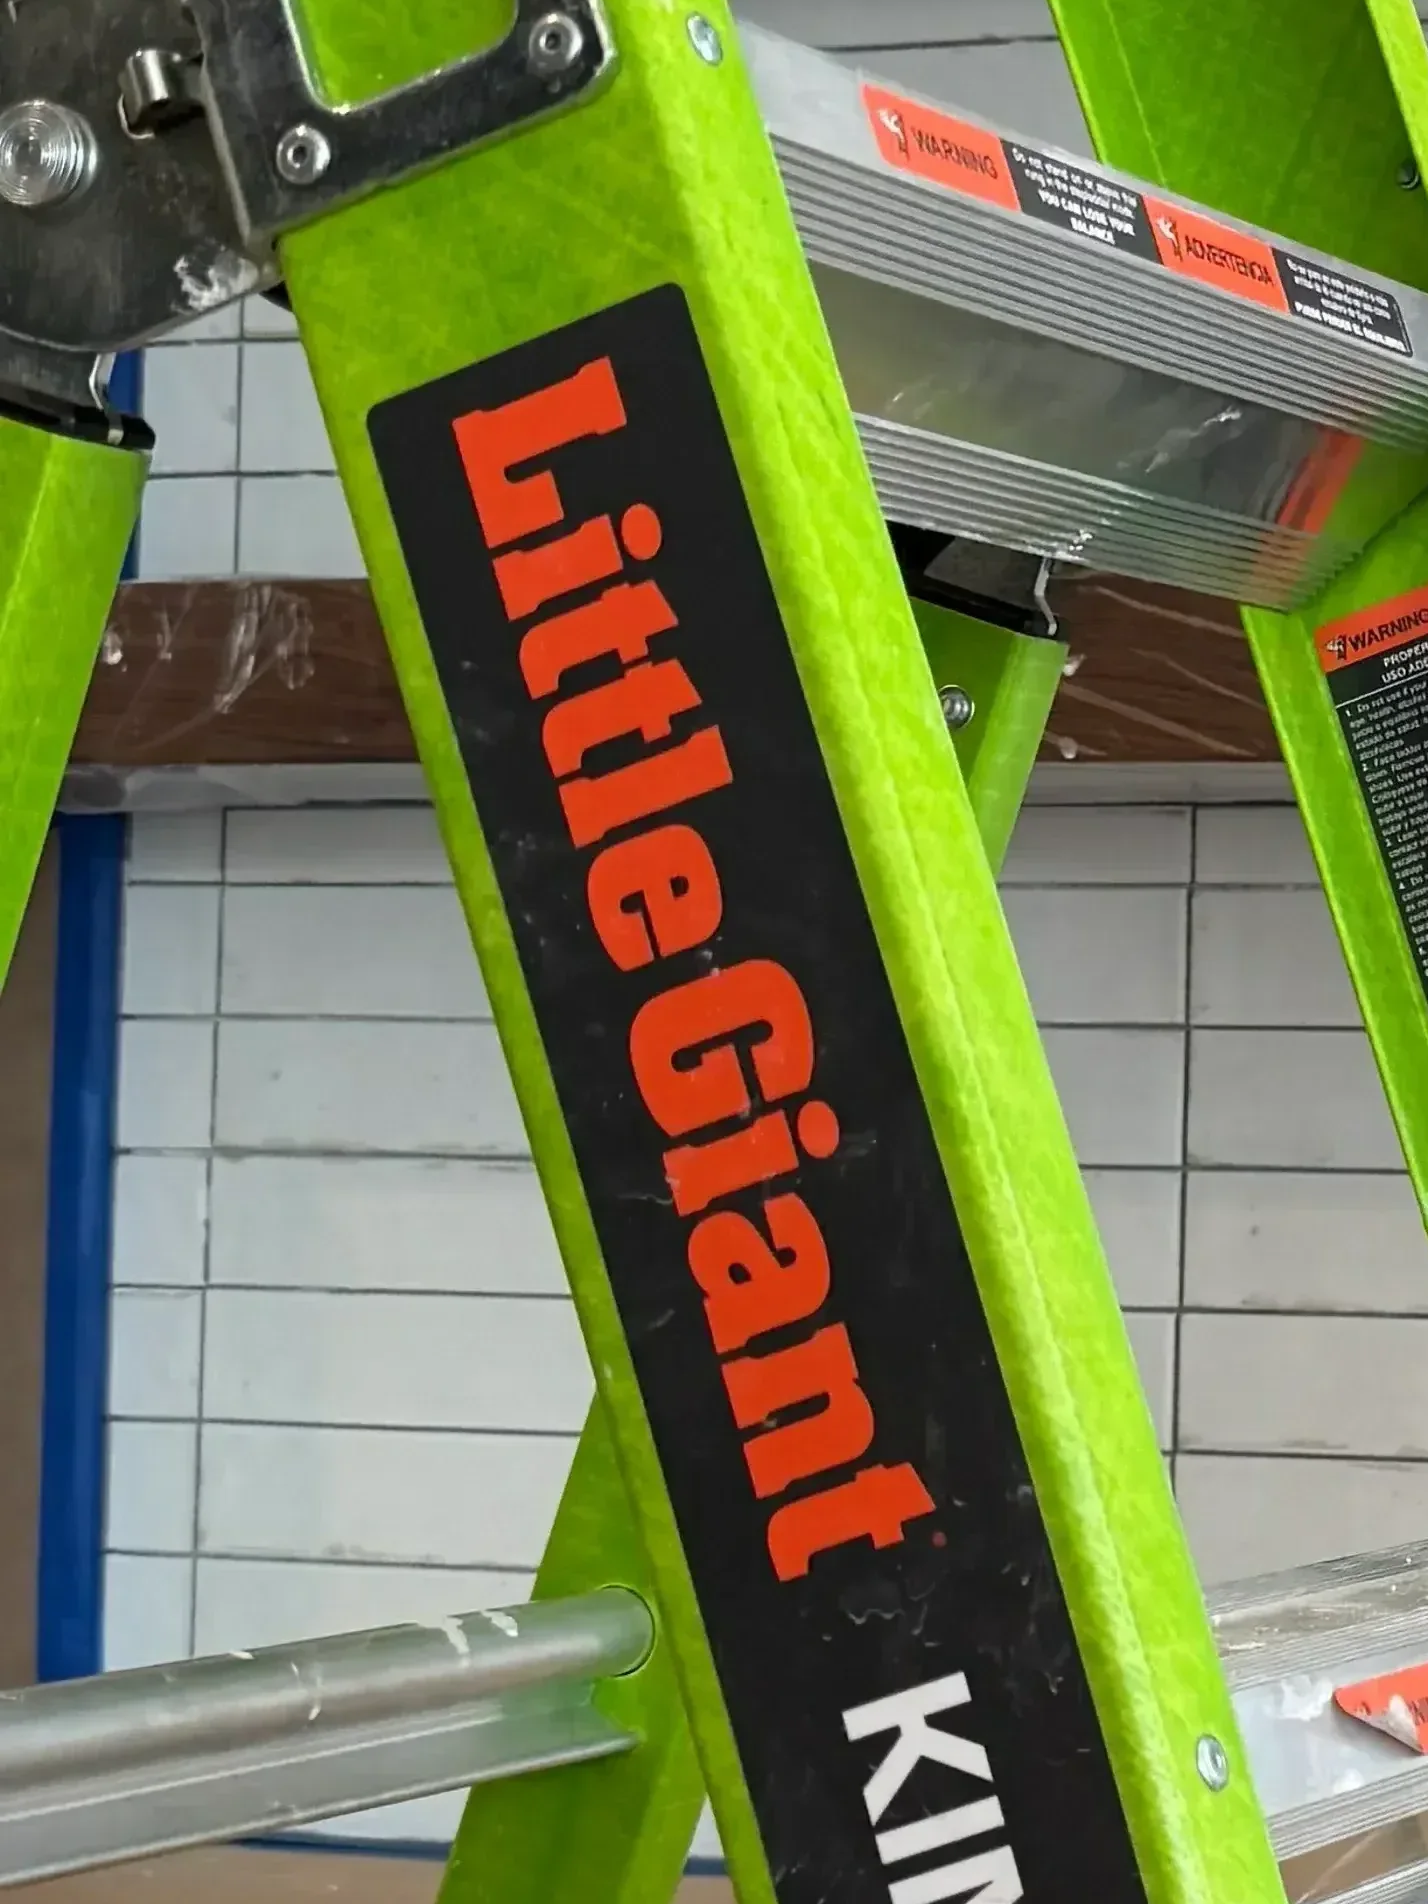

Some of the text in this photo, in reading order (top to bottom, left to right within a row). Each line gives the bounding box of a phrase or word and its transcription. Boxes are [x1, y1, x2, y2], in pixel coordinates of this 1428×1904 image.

[911, 127, 998, 179] WARNING
[1185, 235, 1273, 285] ADVERTENCIA
[1381, 667, 1408, 683] USO
